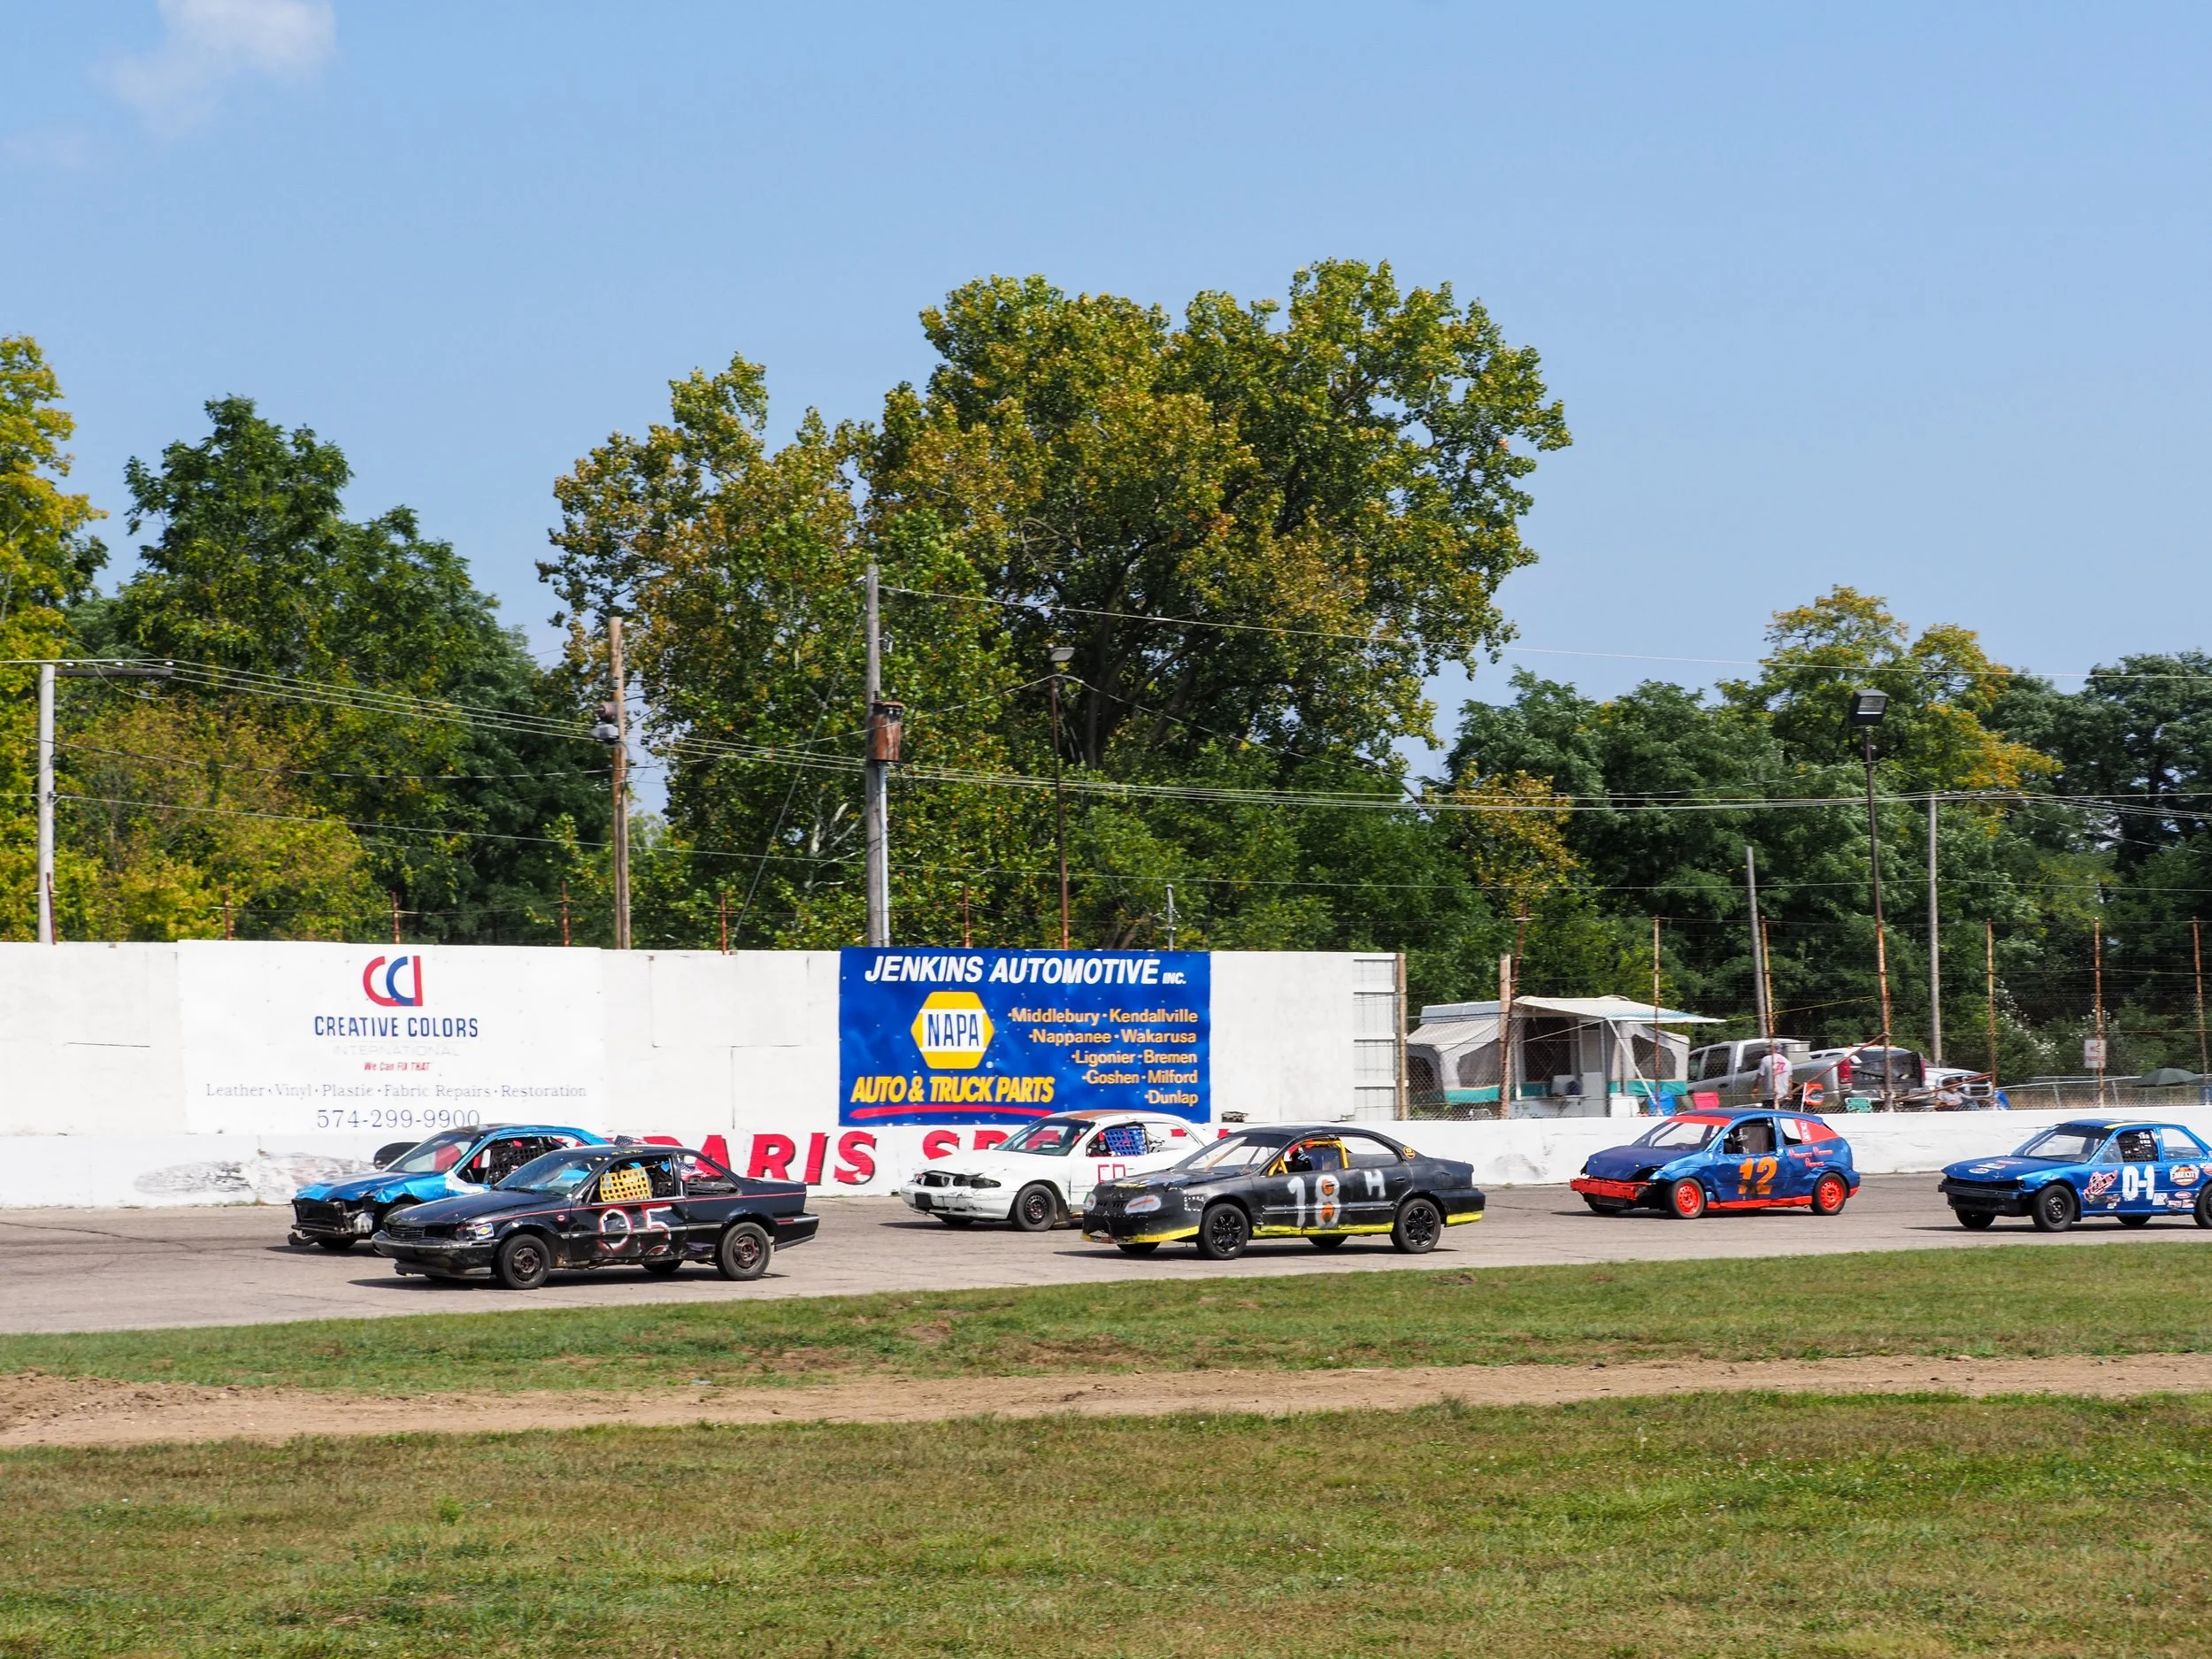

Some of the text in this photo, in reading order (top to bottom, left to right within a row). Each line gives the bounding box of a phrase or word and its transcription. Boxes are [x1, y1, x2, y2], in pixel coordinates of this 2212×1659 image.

[864, 955, 1187, 985] JENKINS AUTOMOTIVE INC.
[314, 1015, 479, 1038] CREATIVE COLORS
[1012, 1008, 1198, 1026] Middlebury Kendallville
[926, 1013, 980, 1048] NAPA
[1033, 1029, 1197, 1045] Nappanee Wakarusa
[1075, 1049, 1197, 1067] Ligonier Bremen
[1086, 1069, 1198, 1085] Goshen Milford
[206, 1083, 265, 1097] Leather
[275, 1084, 311, 1100] Vinyl
[384, 1085, 428, 1097] Fabric
[435, 1085, 492, 1102] Repairs
[501, 1086, 587, 1098] Restoration
[850, 1077, 1056, 1103] AUTO & TRUCK PARTS
[1148, 1089, 1199, 1107] Dunlap
[317, 1109, 481, 1129] 574-299-9900
[644, 1130, 877, 1186] ARIS
[1738, 1156, 1778, 1194] 12
[1286, 1174, 1340, 1229] 18
